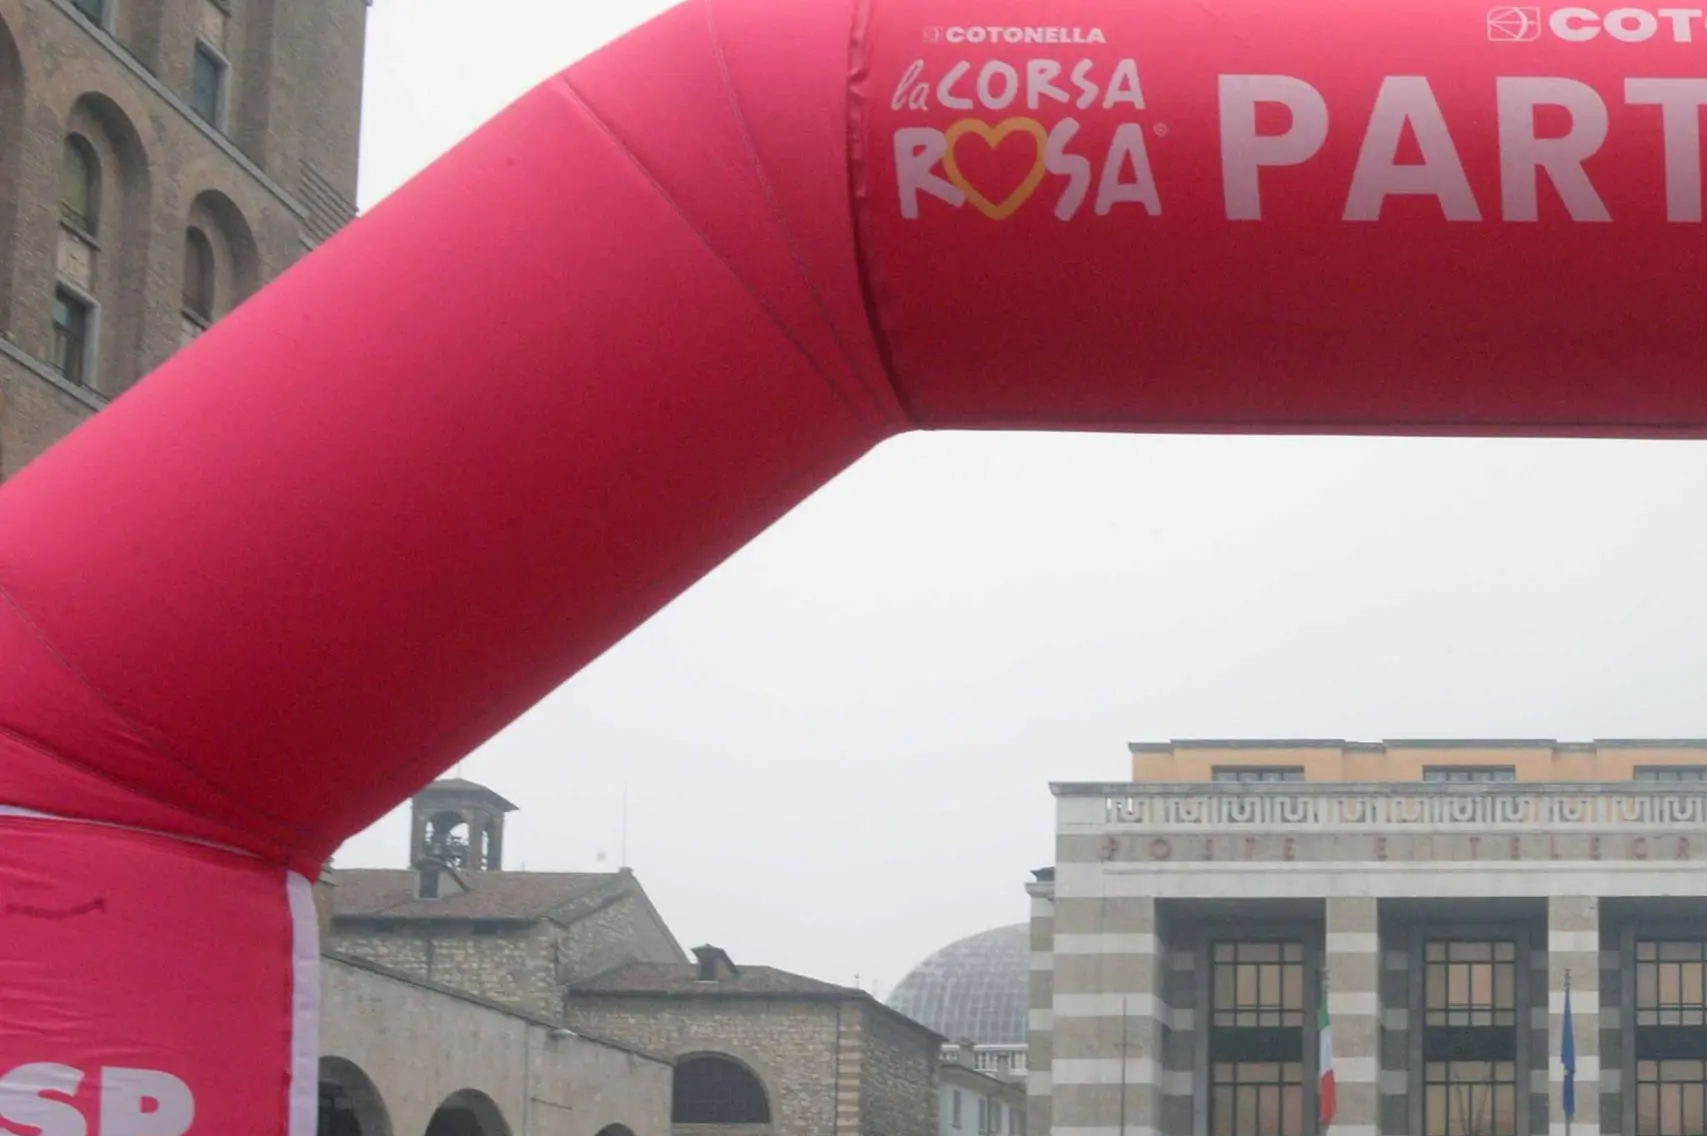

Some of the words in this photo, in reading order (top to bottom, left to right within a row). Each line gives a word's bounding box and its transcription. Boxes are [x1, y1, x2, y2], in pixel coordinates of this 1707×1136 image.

[946, 26, 1107, 44] COTONELLA
[891, 59, 930, 111] la
[937, 58, 1146, 110] CORSA
